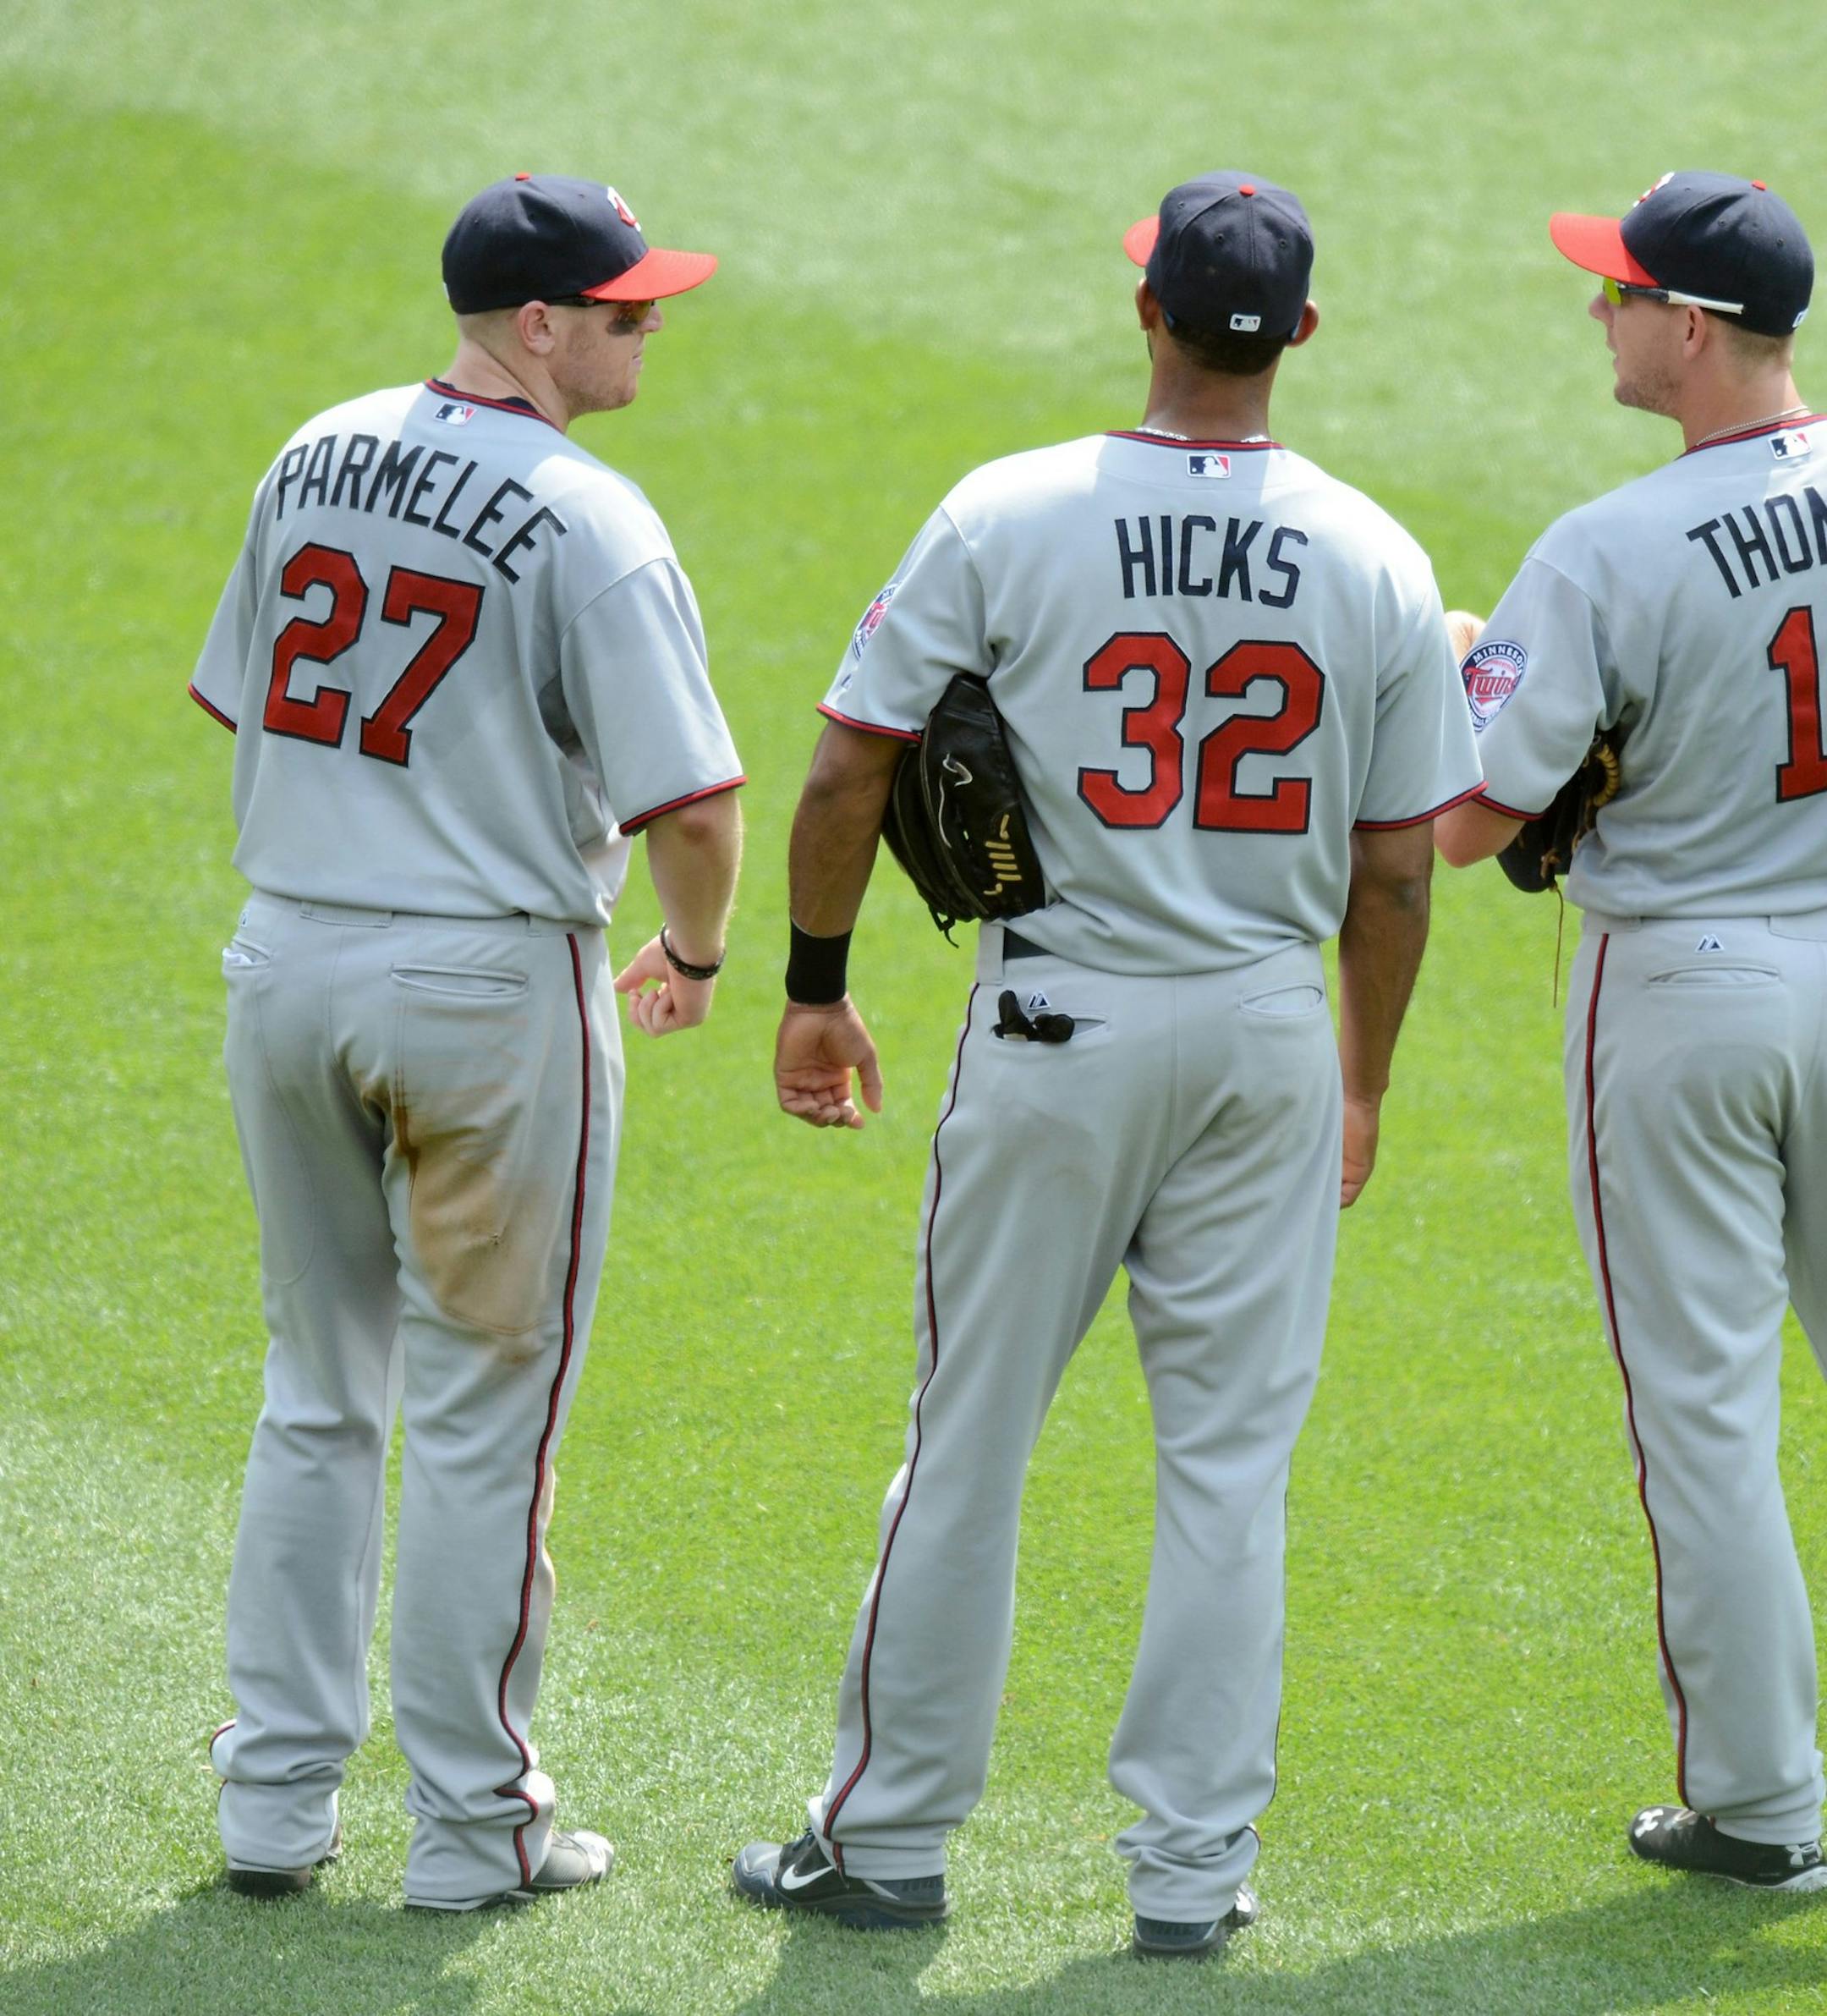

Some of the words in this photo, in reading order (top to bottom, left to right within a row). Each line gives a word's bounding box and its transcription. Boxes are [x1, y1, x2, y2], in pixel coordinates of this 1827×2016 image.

[277, 433, 568, 585] PARMELEE
[1115, 514, 1309, 609] HICKS
[263, 541, 486, 768] 27
[1078, 631, 1325, 834] 32
